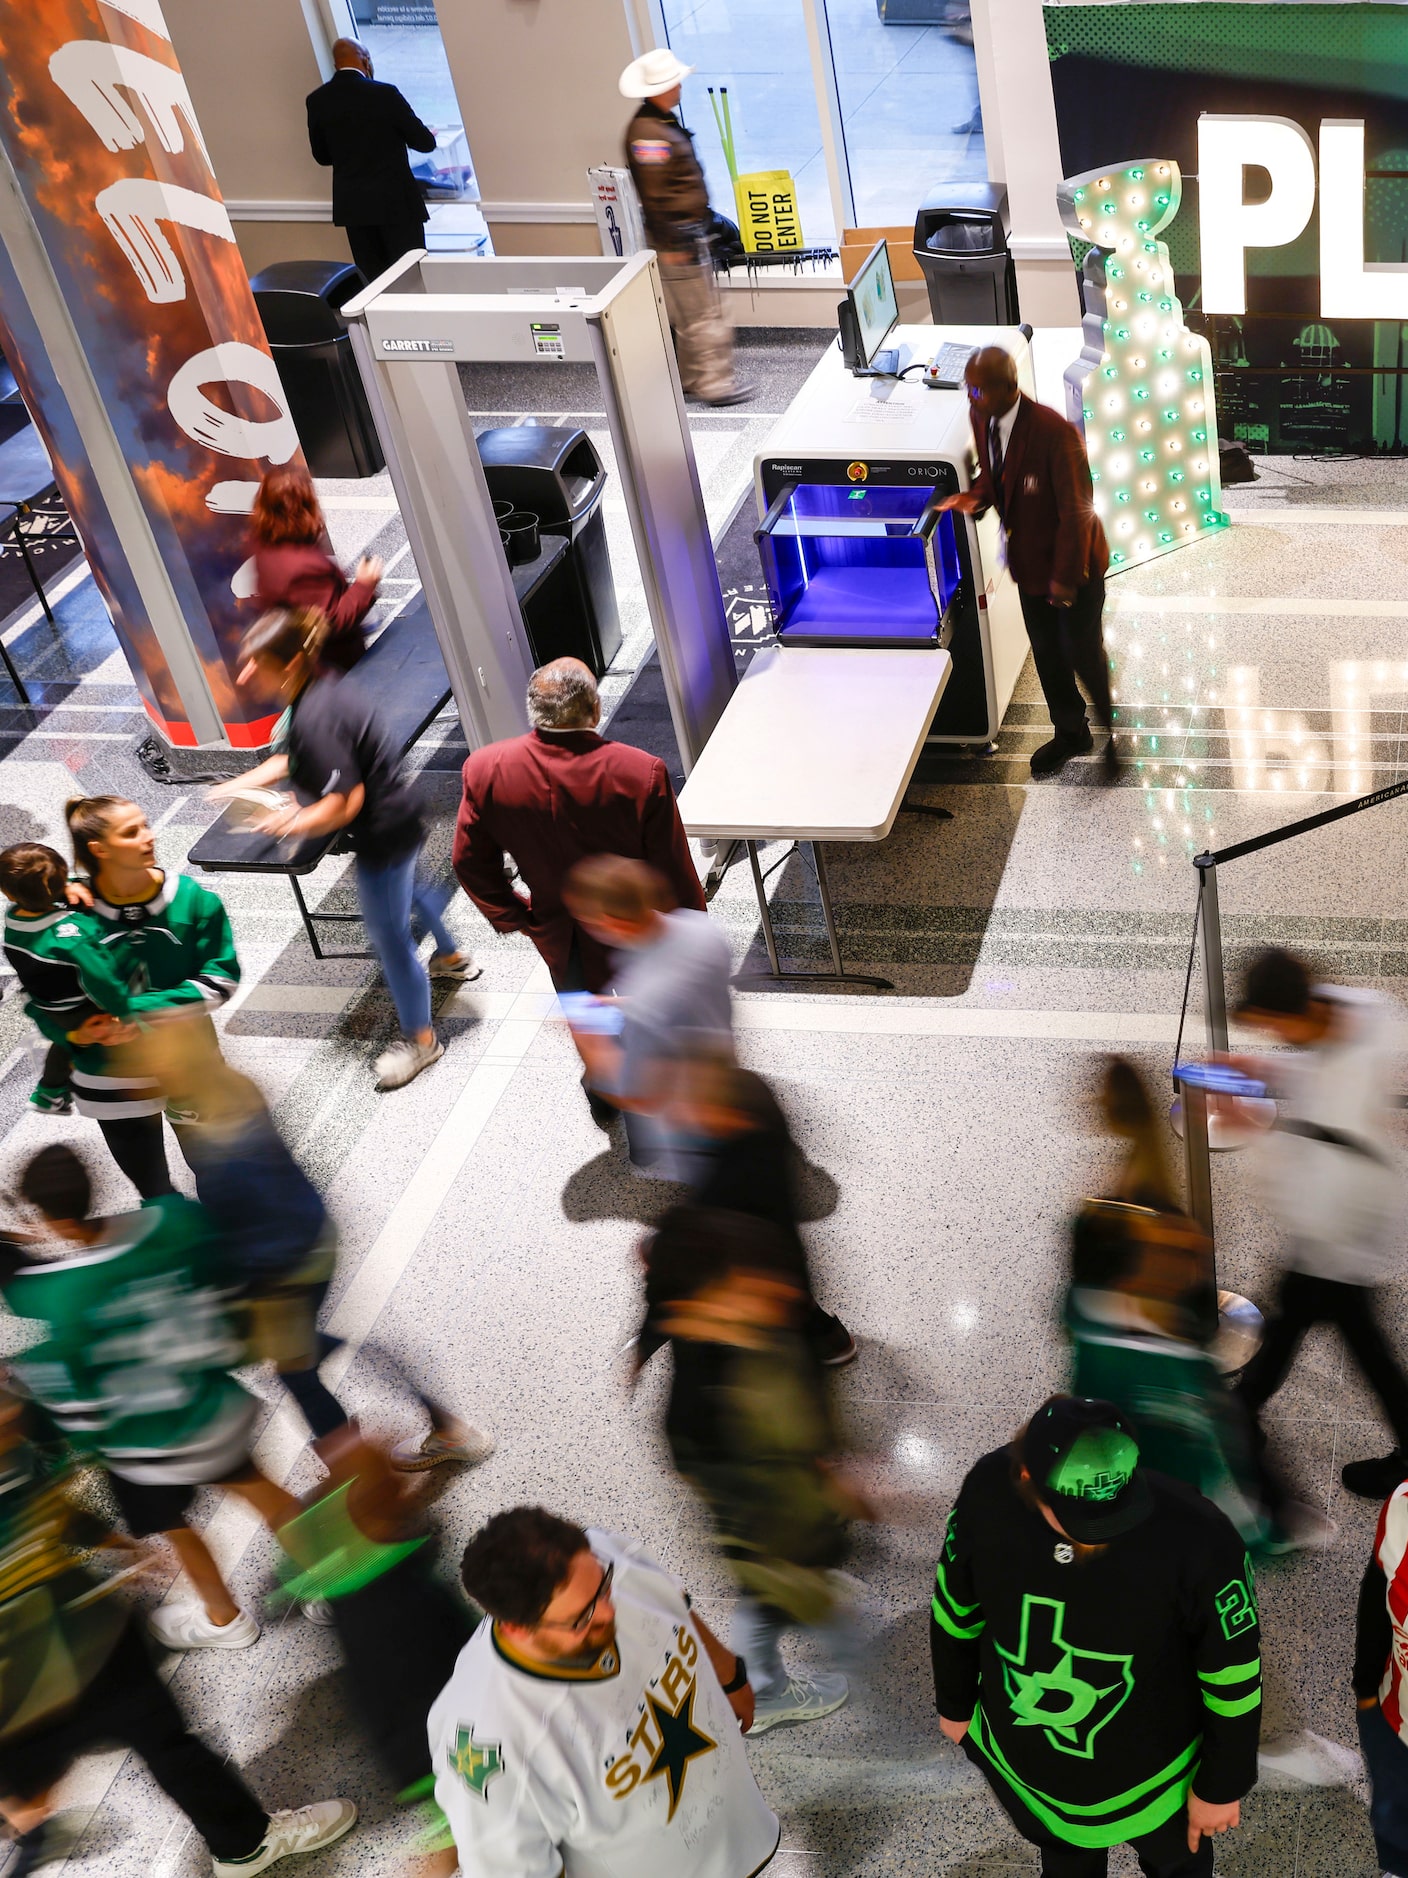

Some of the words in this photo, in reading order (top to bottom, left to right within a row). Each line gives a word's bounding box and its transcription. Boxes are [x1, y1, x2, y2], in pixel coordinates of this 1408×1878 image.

[748, 191, 770, 224] NOT
[773, 193, 797, 248] ENTER
[754, 230, 773, 251] DO
[382, 339, 431, 352] GARRETT
[771, 464, 803, 472] Rapiscan
[907, 466, 948, 478] ORION
[605, 1625, 699, 1801] STARS
